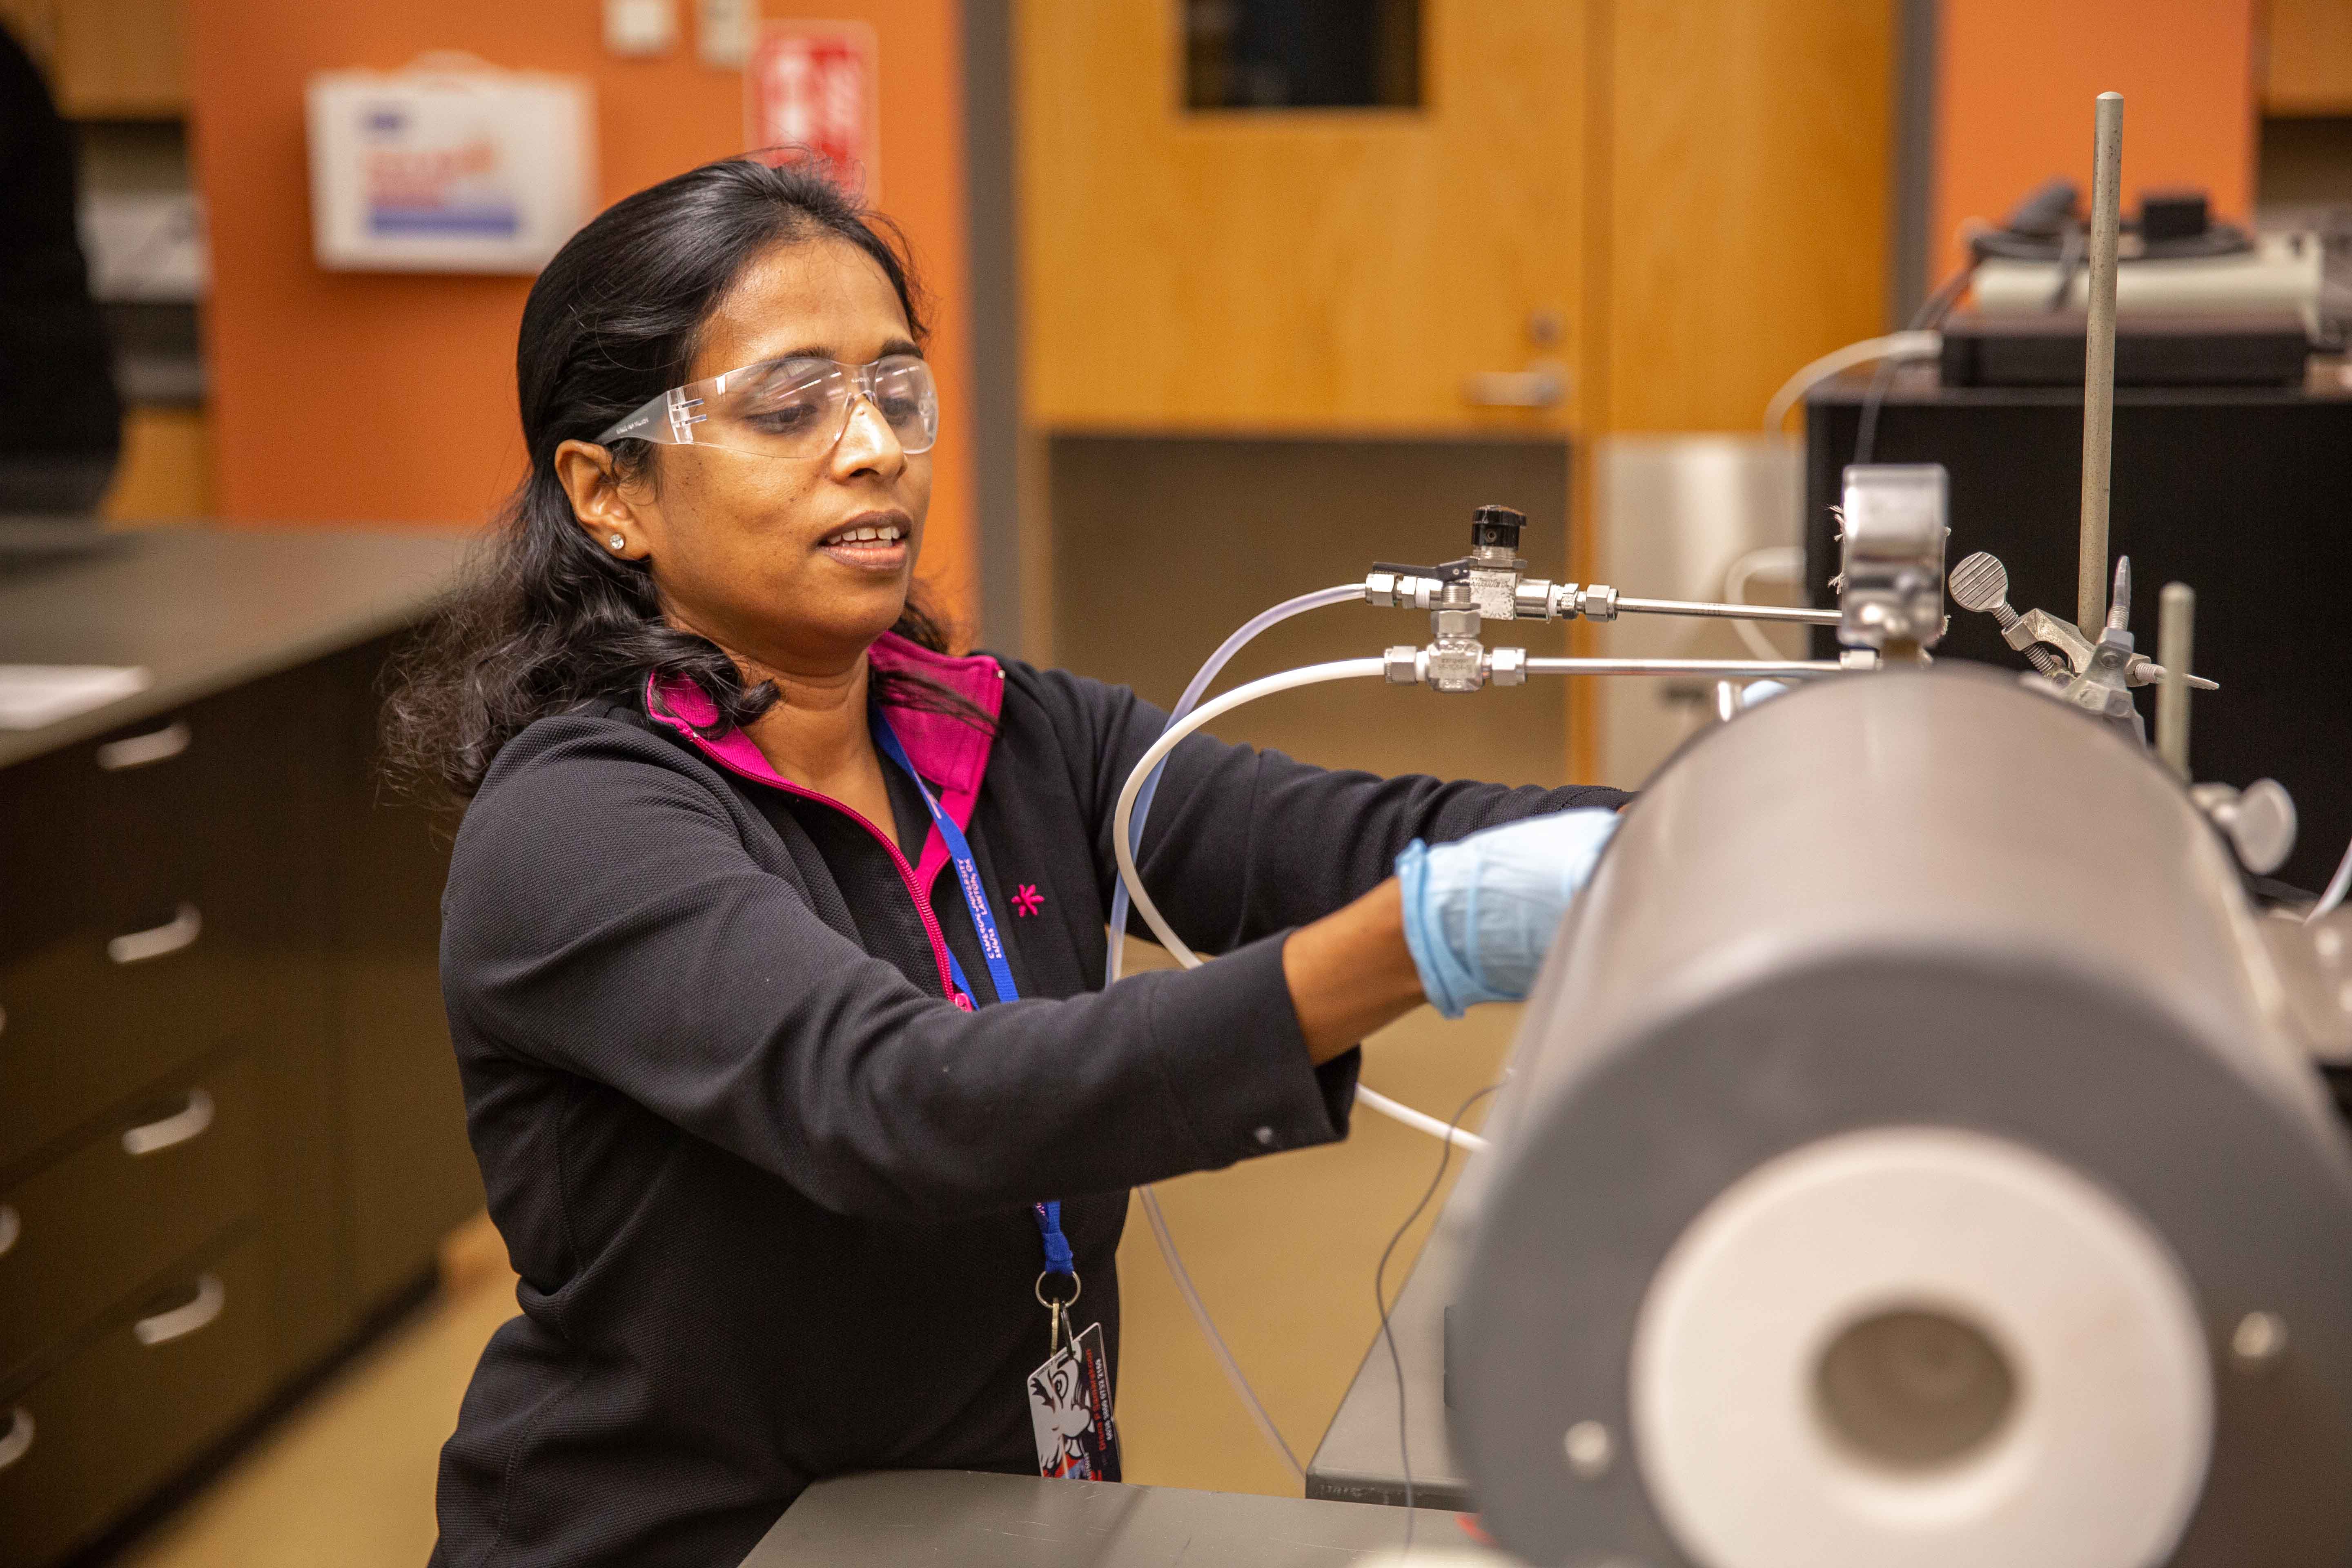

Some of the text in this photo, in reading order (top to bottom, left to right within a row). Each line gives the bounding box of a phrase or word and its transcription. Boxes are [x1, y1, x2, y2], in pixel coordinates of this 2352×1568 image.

[964, 859, 973, 872] OK
[958, 859, 994, 958] CAMERON UNIVERSITY
